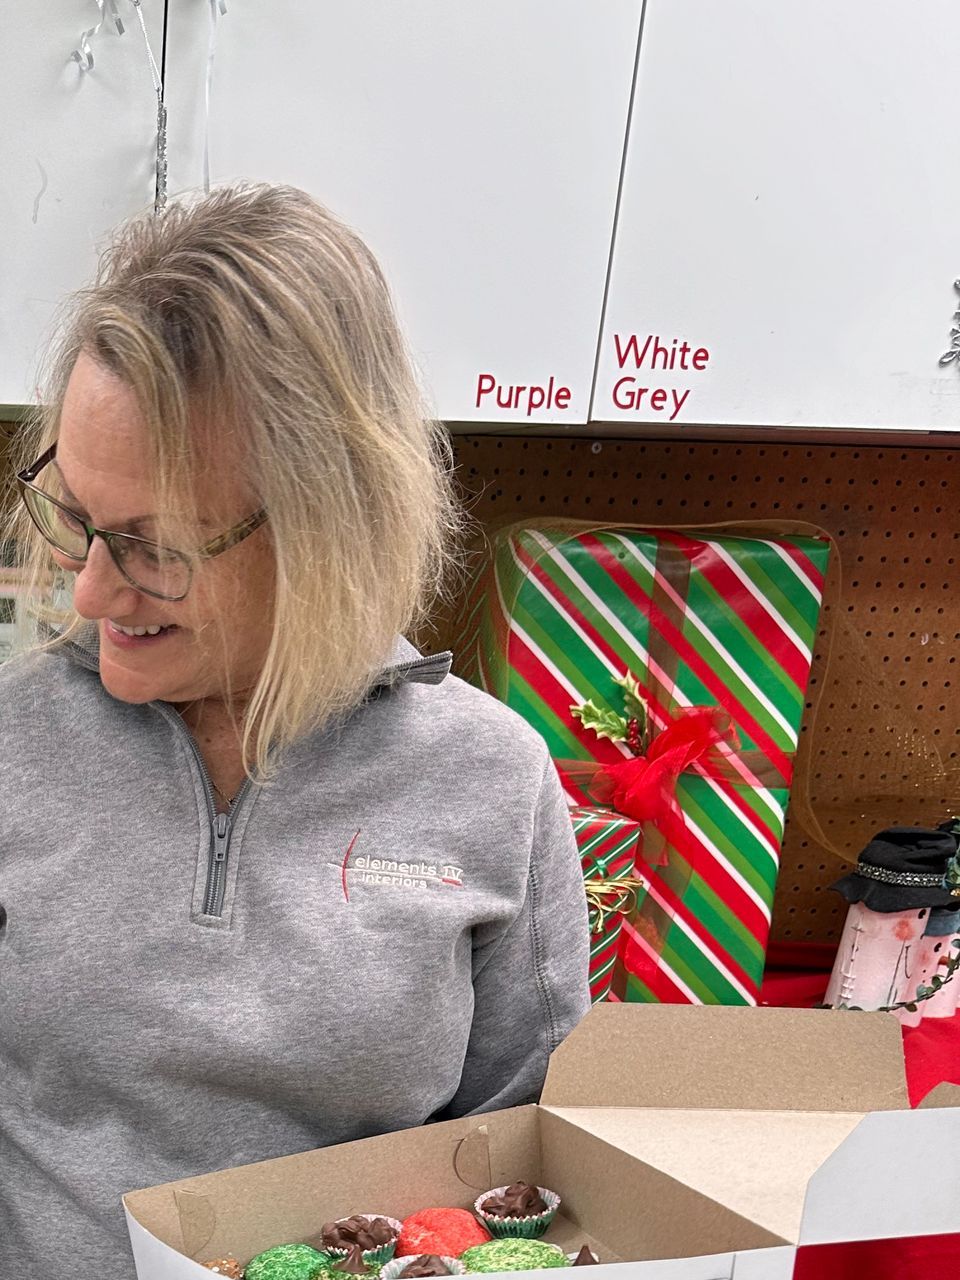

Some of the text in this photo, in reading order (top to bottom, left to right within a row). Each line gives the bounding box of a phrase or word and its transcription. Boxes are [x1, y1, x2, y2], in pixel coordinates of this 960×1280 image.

[614, 334, 709, 371] White
[476, 374, 572, 416] Purple
[612, 376, 690, 421] Grey
[355, 855, 437, 875] elements
[361, 871, 428, 889] interiors
